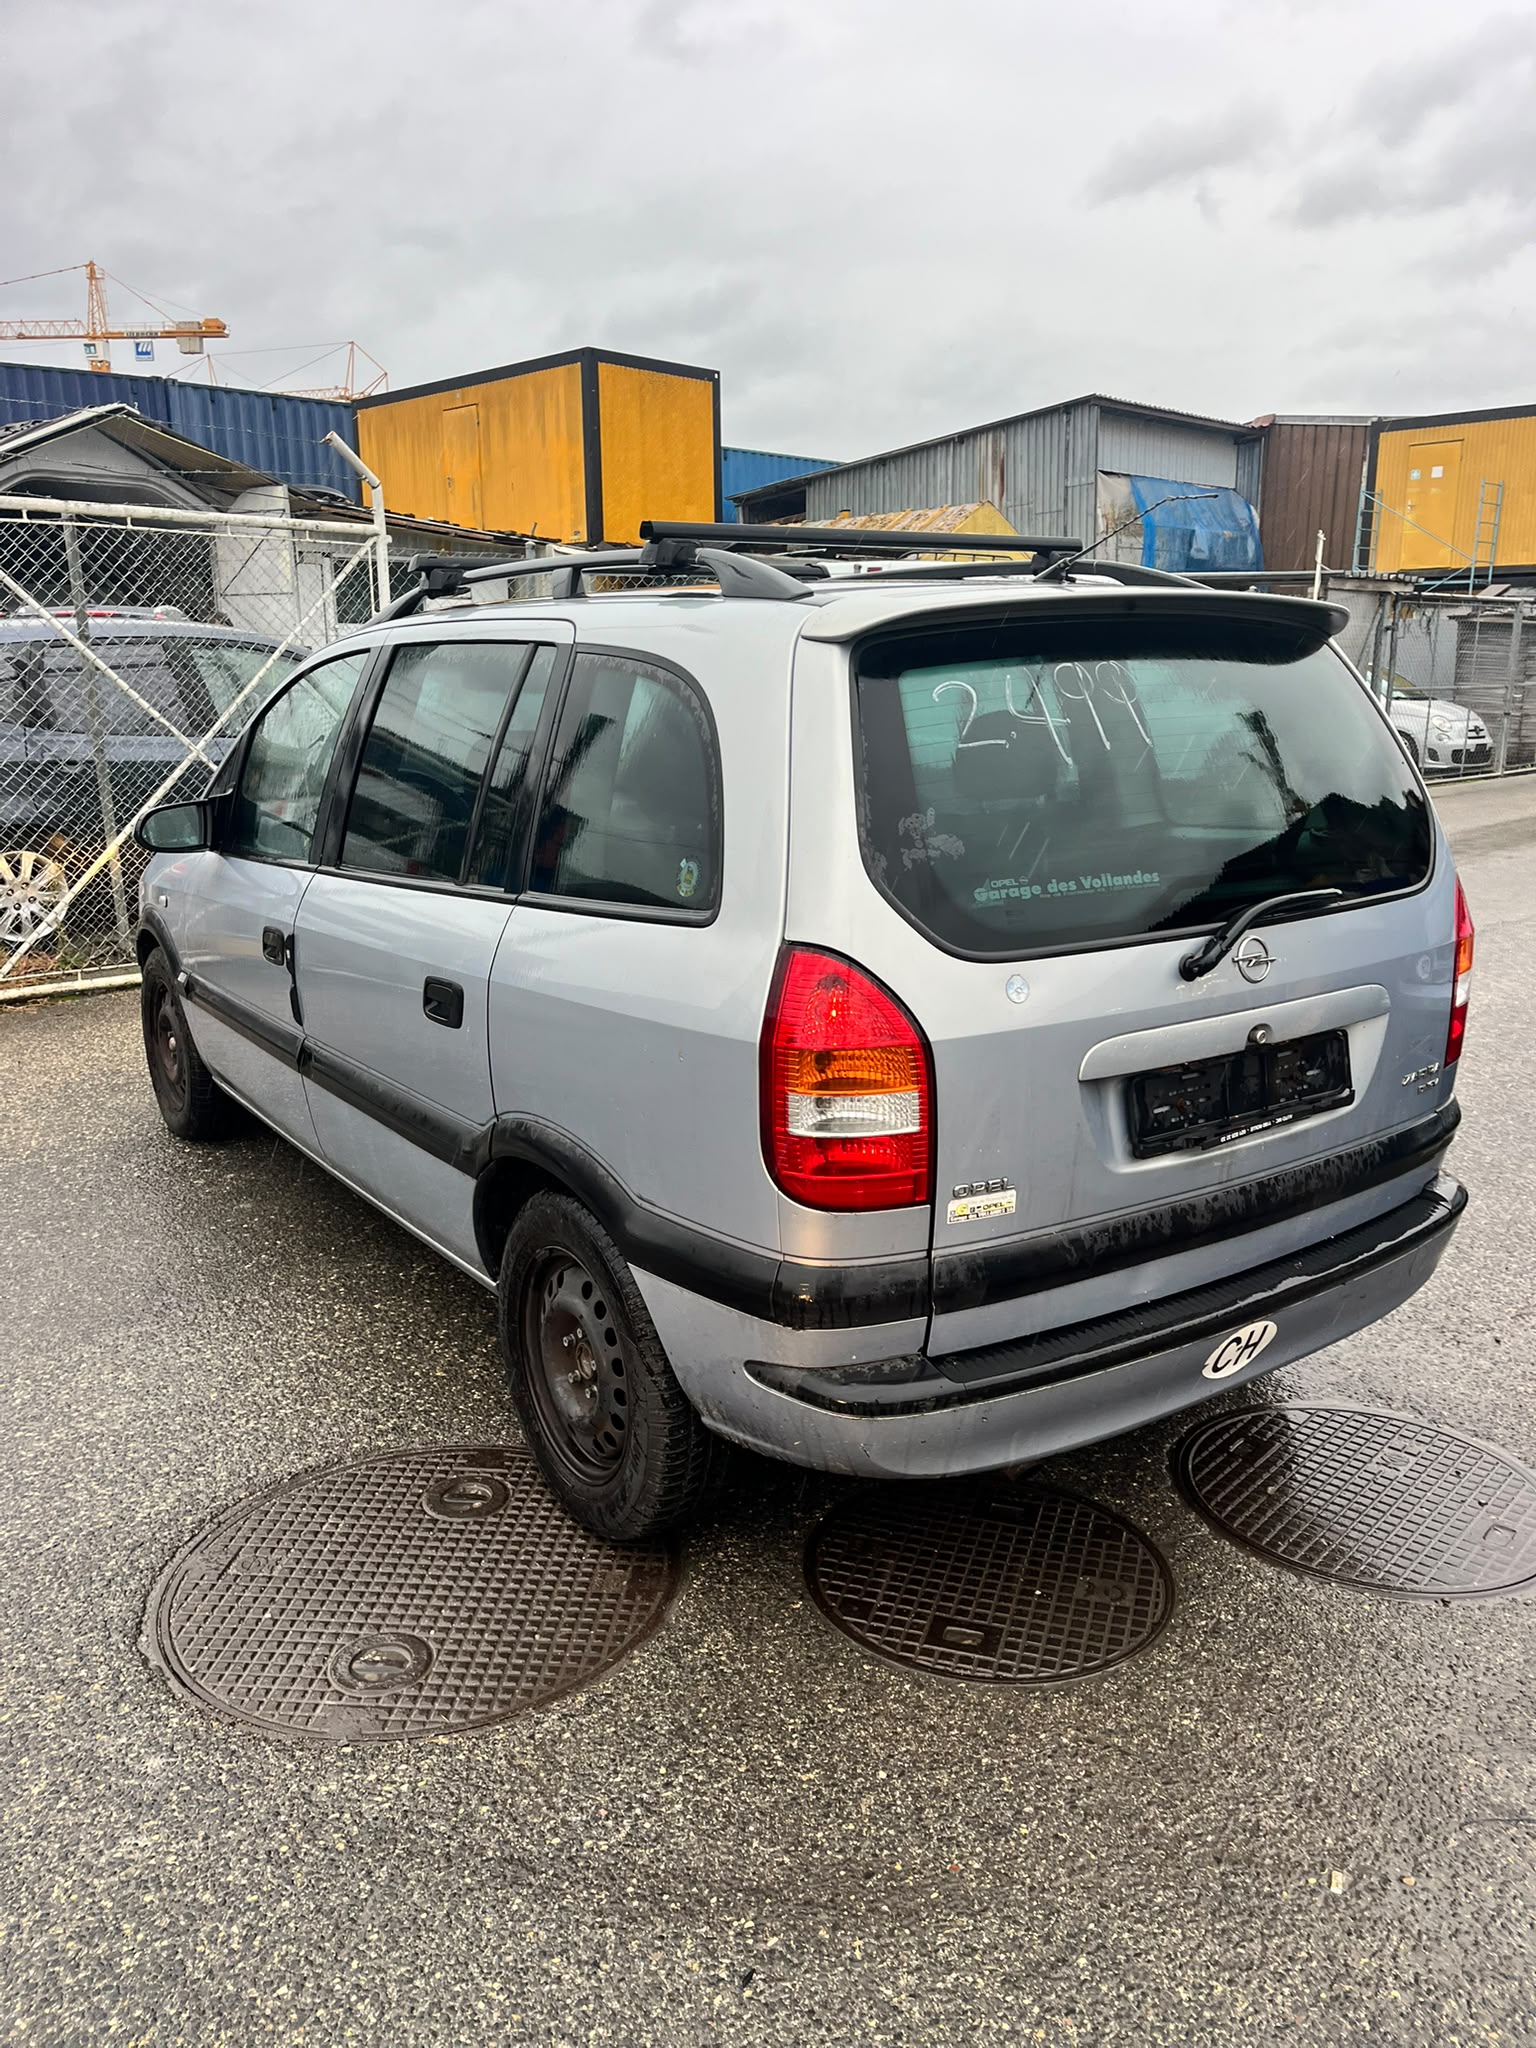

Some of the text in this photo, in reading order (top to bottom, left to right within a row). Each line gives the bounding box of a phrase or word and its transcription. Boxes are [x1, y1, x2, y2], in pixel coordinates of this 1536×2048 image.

[973, 884, 1042, 901] Garage
[1047, 879, 1077, 893] des
[990, 878, 1019, 888] OPEL
[952, 1176, 1015, 1199] OPEL
[1211, 1324, 1269, 1374] CH
